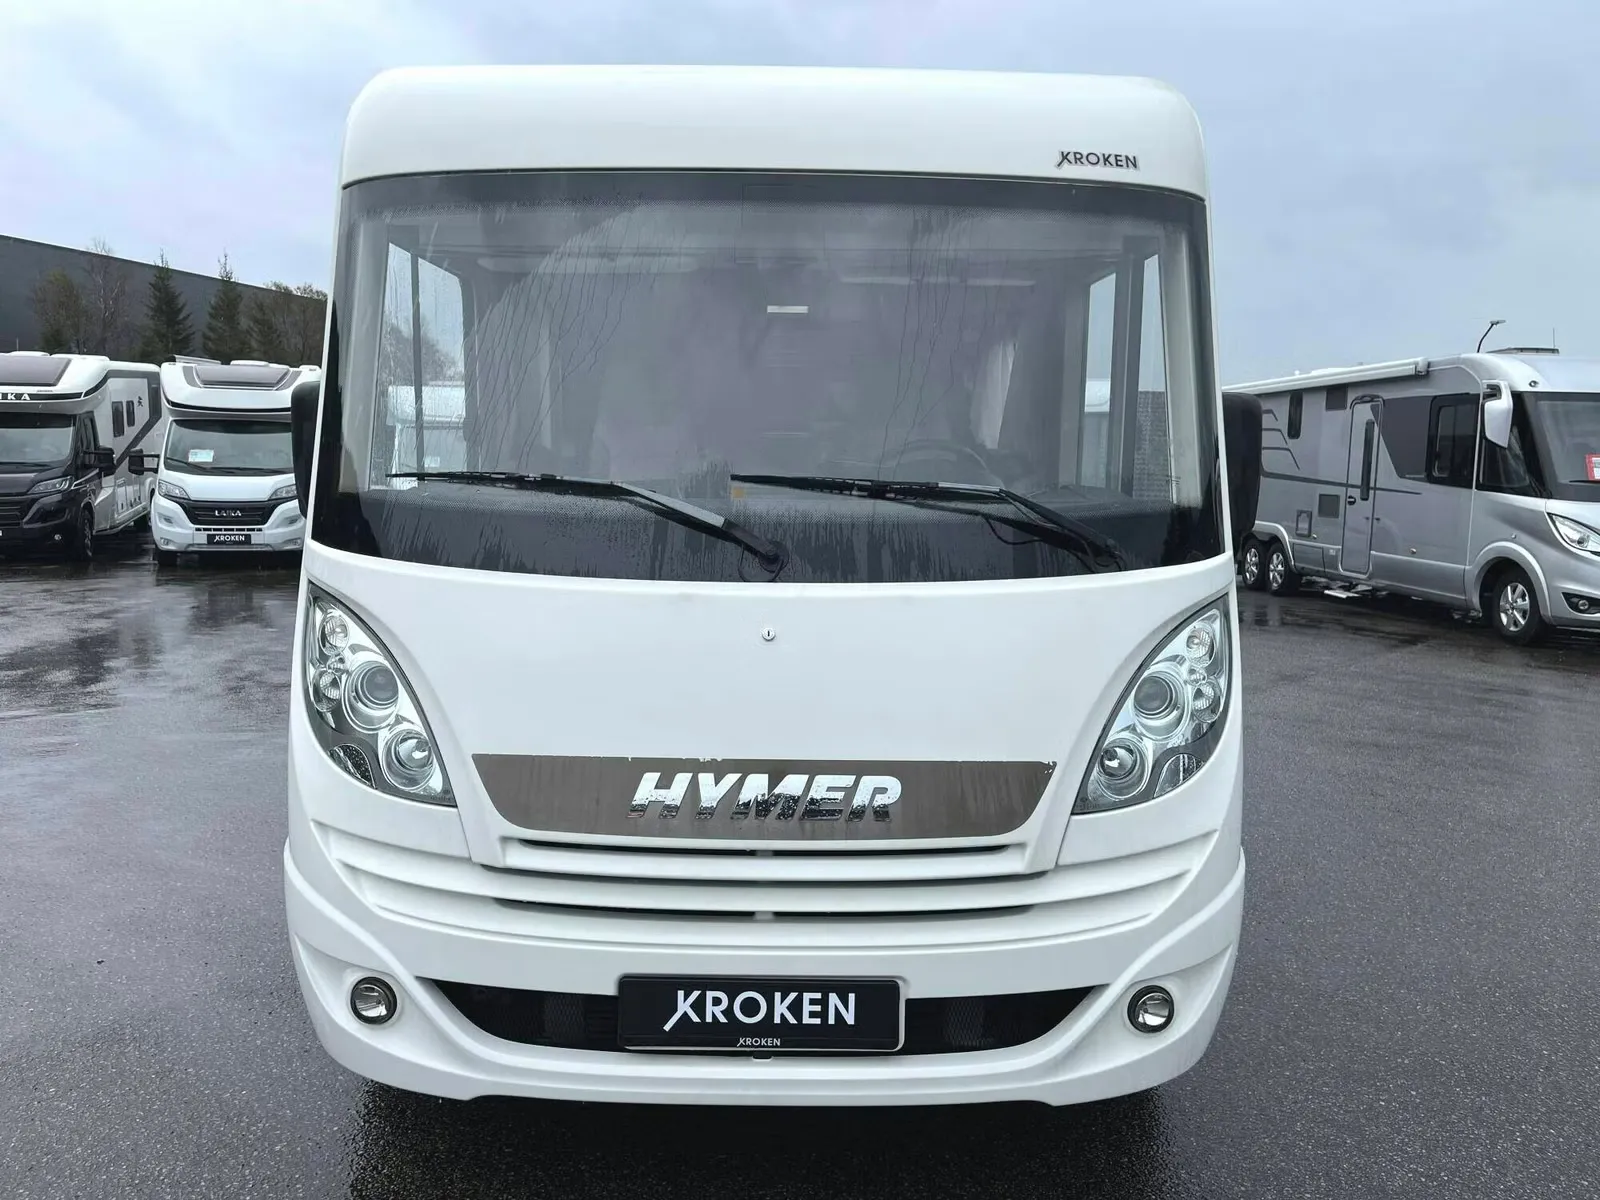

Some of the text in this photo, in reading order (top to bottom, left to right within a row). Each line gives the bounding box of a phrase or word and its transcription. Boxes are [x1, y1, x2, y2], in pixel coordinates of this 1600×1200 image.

[1056, 151, 1138, 169] KROKEN
[213, 535, 245, 543] KROKEN
[626, 772, 902, 823] HYMER
[662, 989, 856, 1032] KROKEN
[736, 1037, 781, 1047] KROKEN
